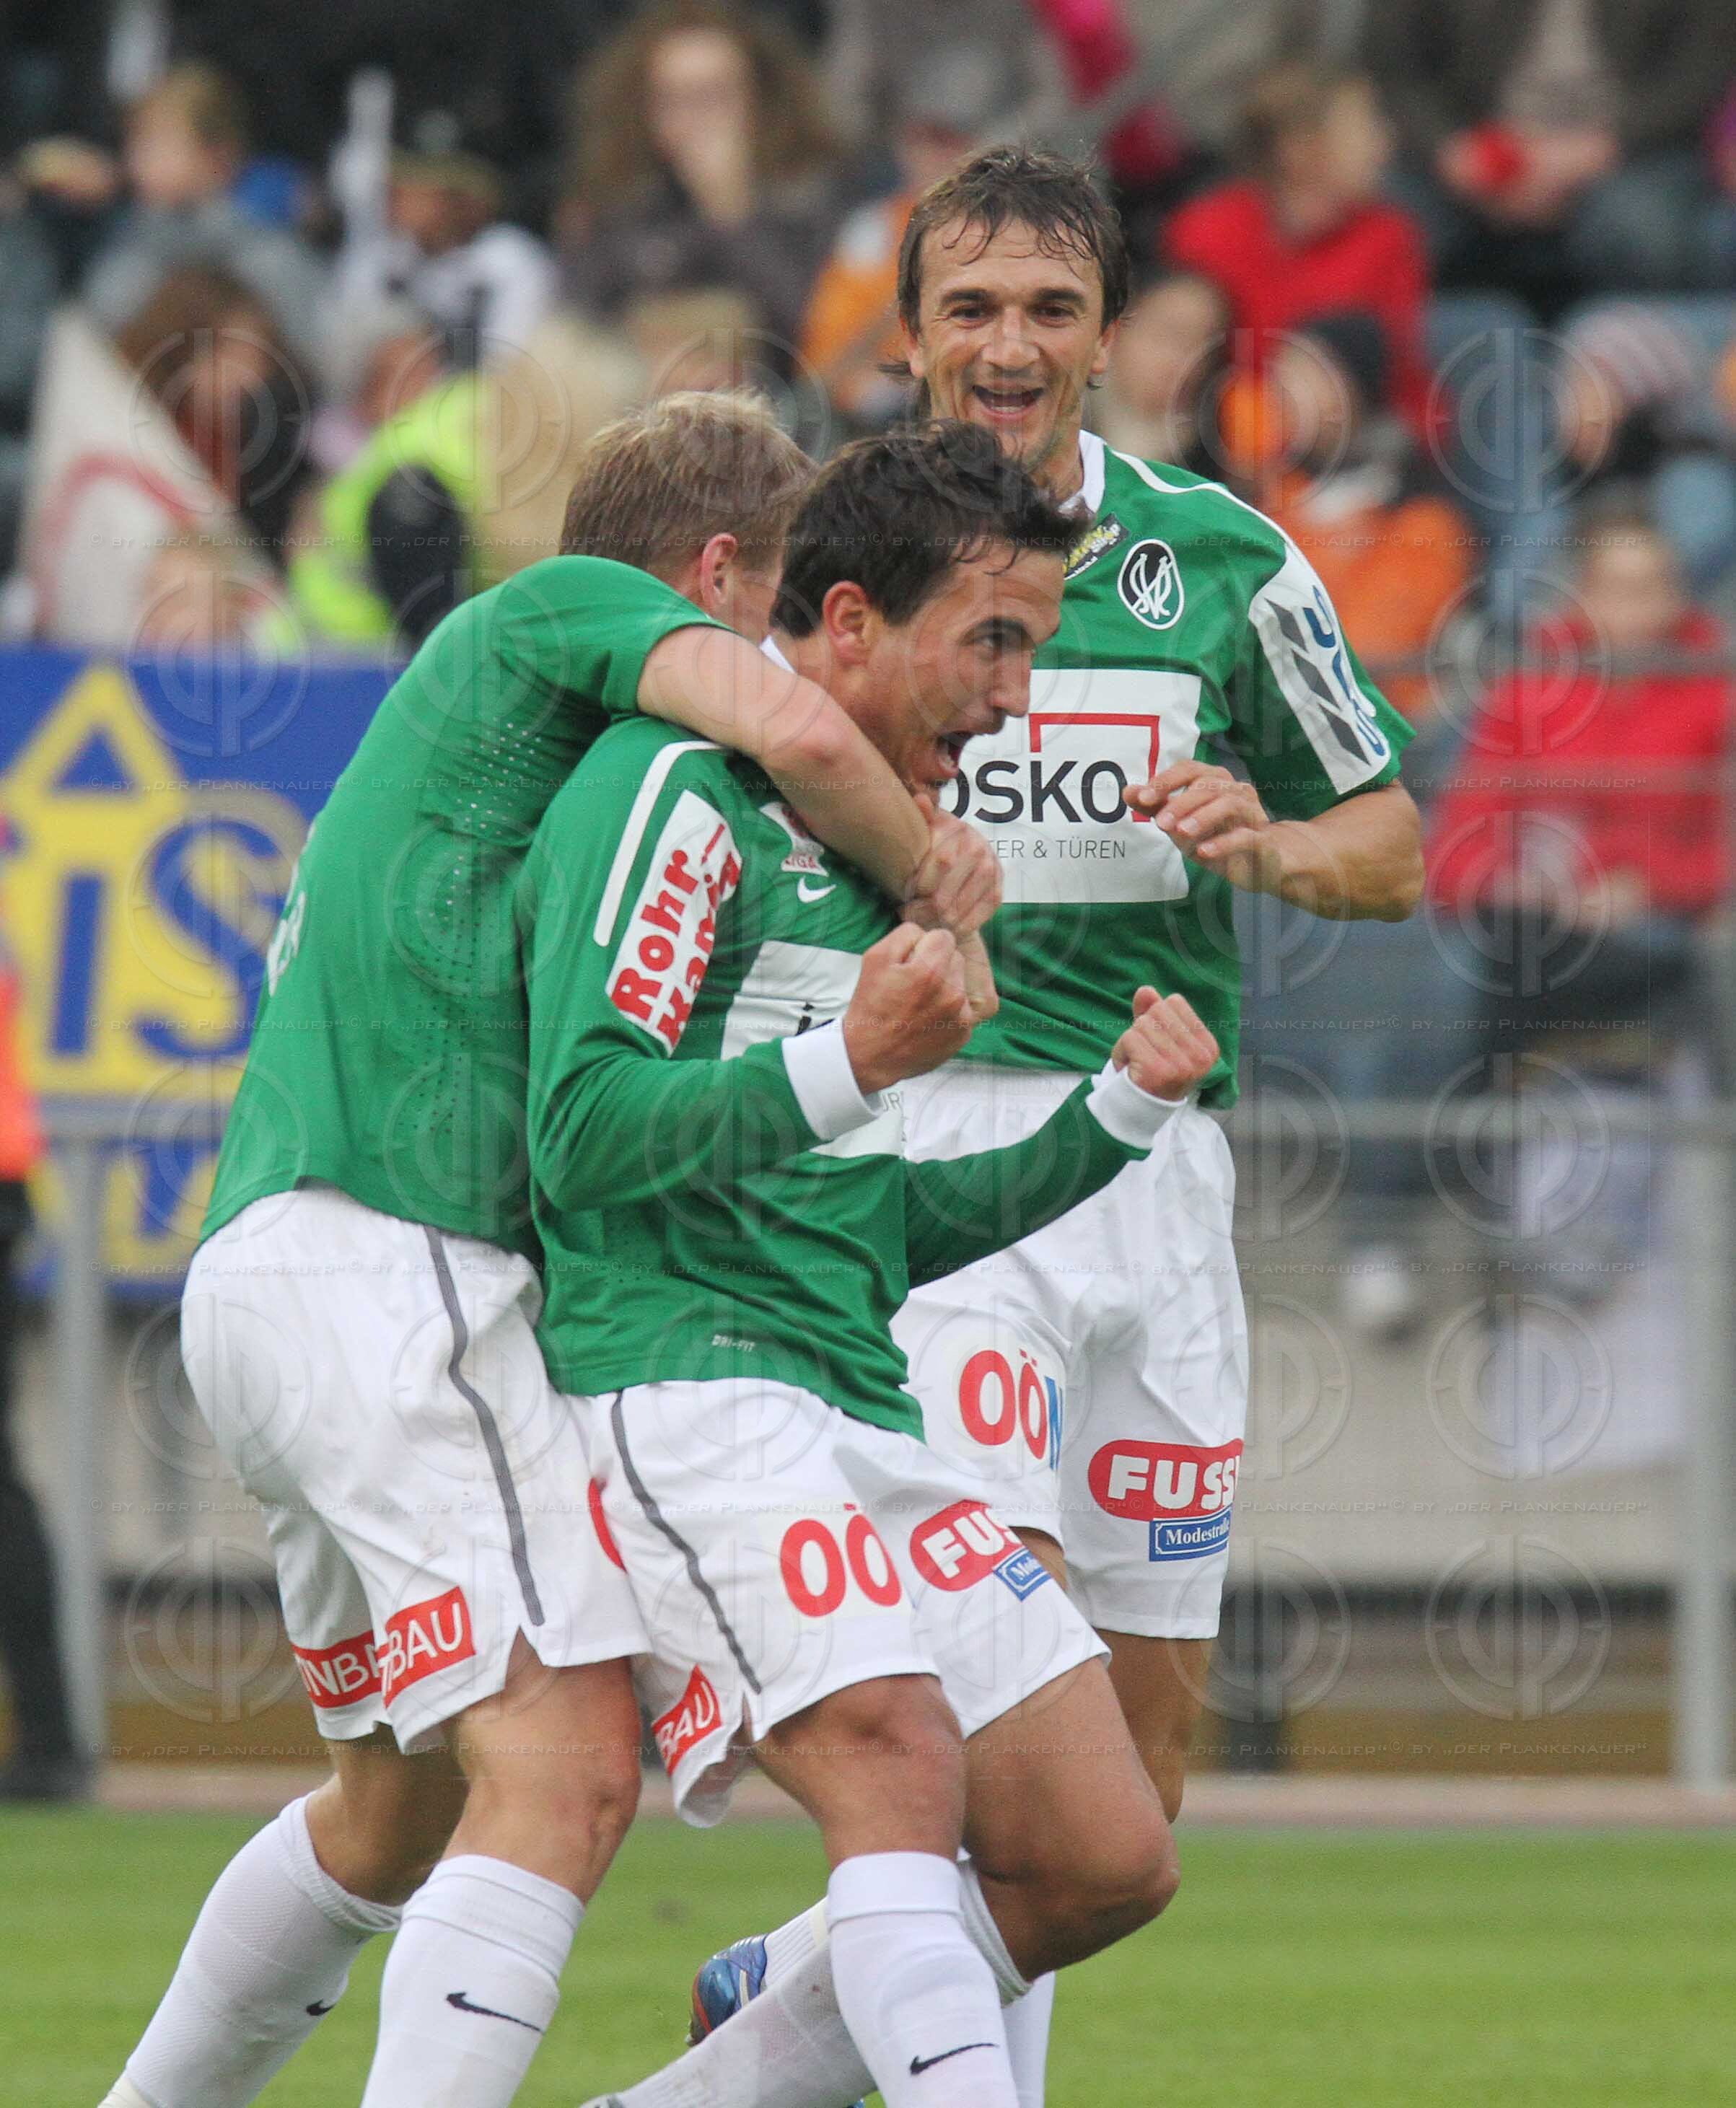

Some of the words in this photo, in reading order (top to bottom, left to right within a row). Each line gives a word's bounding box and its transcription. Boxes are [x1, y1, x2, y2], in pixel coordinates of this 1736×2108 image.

[991, 840, 1024, 859] ER
[1056, 836, 1126, 859] TÜREN
[1108, 1454, 1240, 1511] FUSS
[780, 1503, 902, 1618] OÖ
